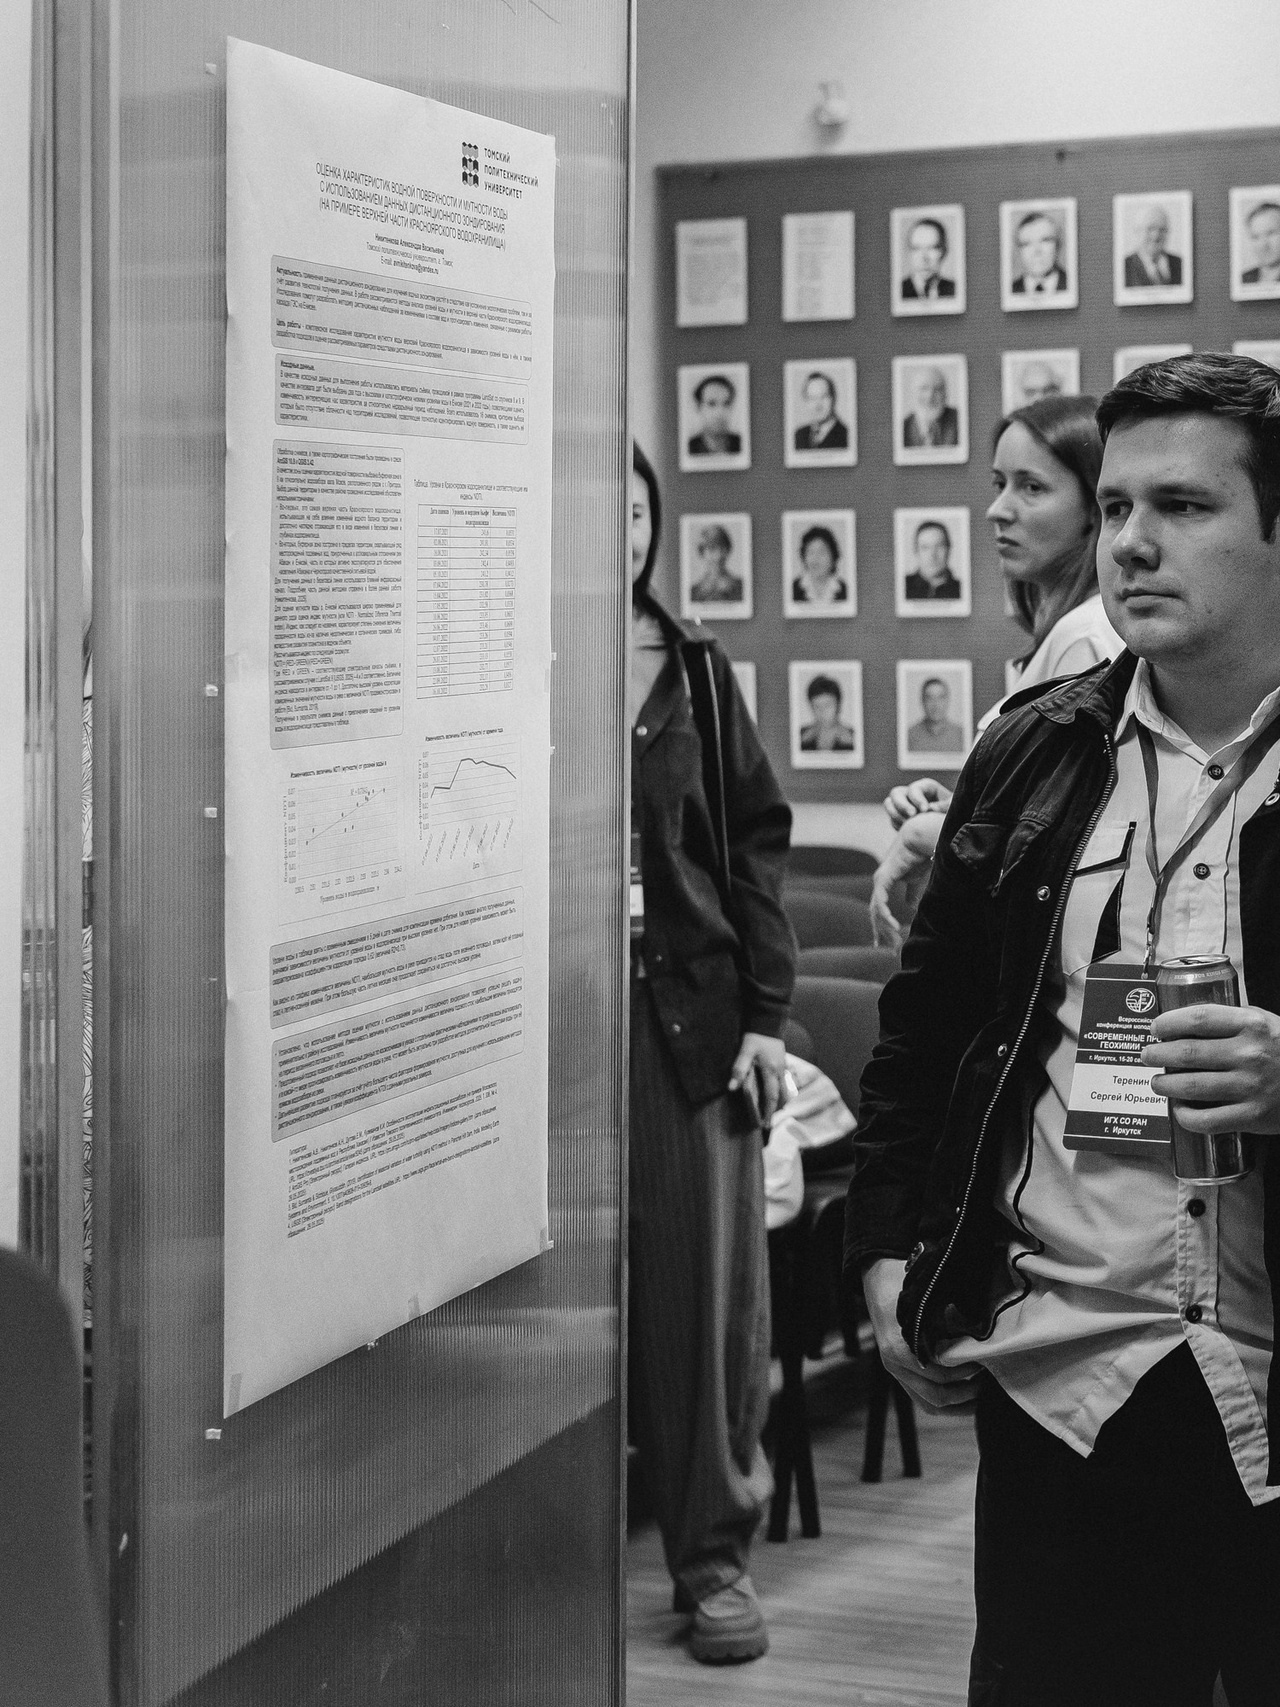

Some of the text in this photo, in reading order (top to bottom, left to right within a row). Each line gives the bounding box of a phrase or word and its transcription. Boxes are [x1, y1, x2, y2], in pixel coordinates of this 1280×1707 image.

[484, 148, 510, 163] ТОМСКИЙ
[485, 165, 538, 187] ПОЛИТЕХНИЧЕСКИЙ
[316, 162, 340, 179] ОЦЕНКА
[342, 168, 390, 191] ХАРАКТЕРИСТИК
[391, 180, 415, 198] ВОДНОЙ
[417, 188, 457, 207] ПОВЕРХНОСТИ
[463, 199, 492, 216] МУТНОСТИ
[493, 206, 508, 220] ВОДЫ
[484, 181, 522, 199] УНИВЕРСИТЕТ
[319, 179, 505, 234] С ИСПОЛЬЗОВАНИЕМ ДАННЫХ ДИСТАНЦИОННОГО ЗОНДИРОВАНИЯ
[319, 196, 329, 211] (НА
[331, 198, 360, 217] ПРИМЕРЕ
[362, 205, 388, 223] ВЕРХНЕЙ
[389, 212, 408, 228] ЧАСТИ
[409, 217, 456, 239] КРАСНОЯРСКОГО
[1084, 1032, 1145, 1042] «СОВРЕМЕННЫЕ
[1100, 1041, 1140, 1050] ГЕОХИМИИ
[1113, 1076, 1150, 1086] Теренин
[1091, 1091, 1166, 1104] Сергей Юрьевич
[1104, 1116, 1147, 1126] ИГХ СО РАН
[1112, 1126, 1142, 1135] Иркутск
